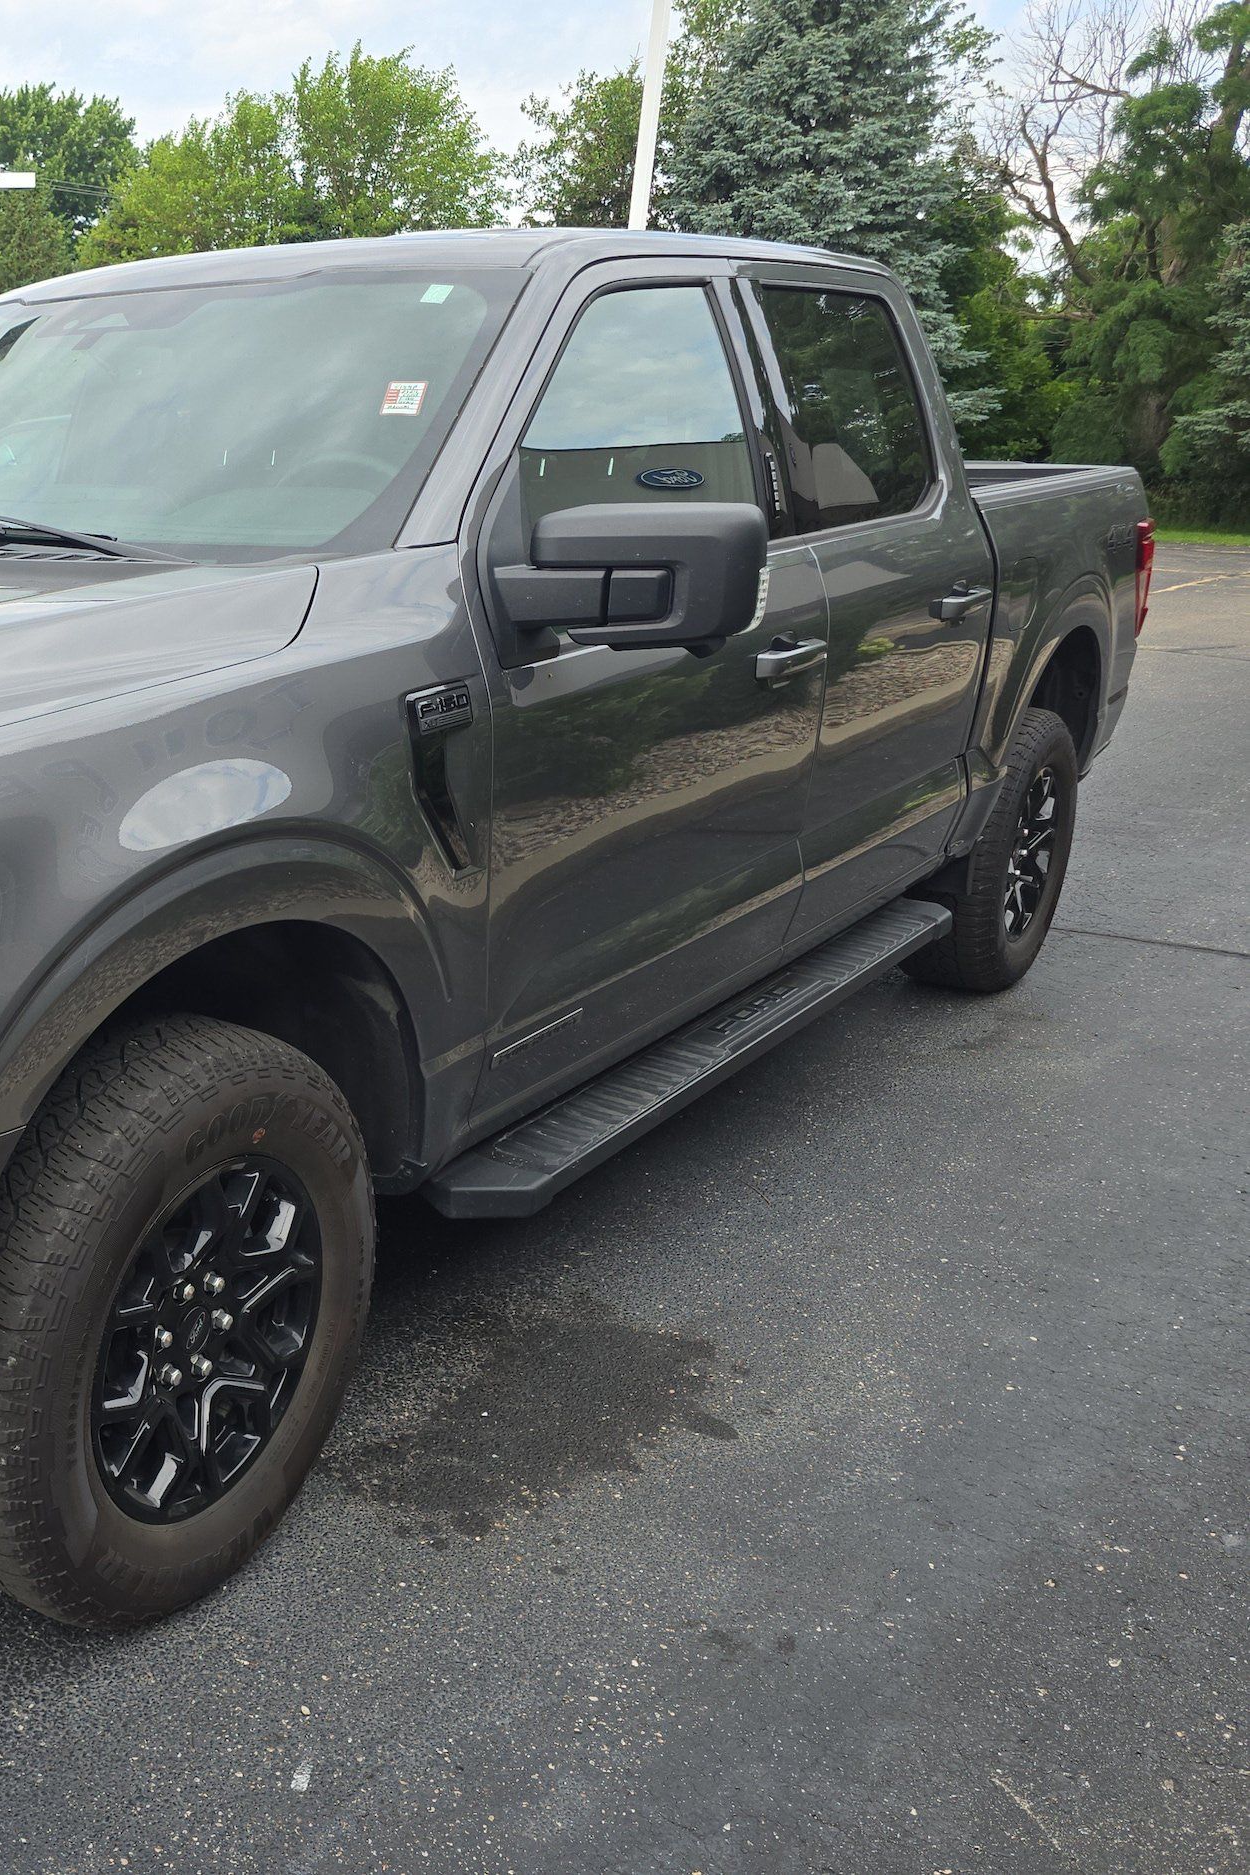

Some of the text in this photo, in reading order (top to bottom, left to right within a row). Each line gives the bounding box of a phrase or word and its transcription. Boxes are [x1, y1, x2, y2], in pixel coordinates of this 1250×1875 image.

[709, 985, 799, 1036] FORD
[185, 1089, 351, 1167] GOODYEAR
[186, 1311, 206, 1350] Ford
